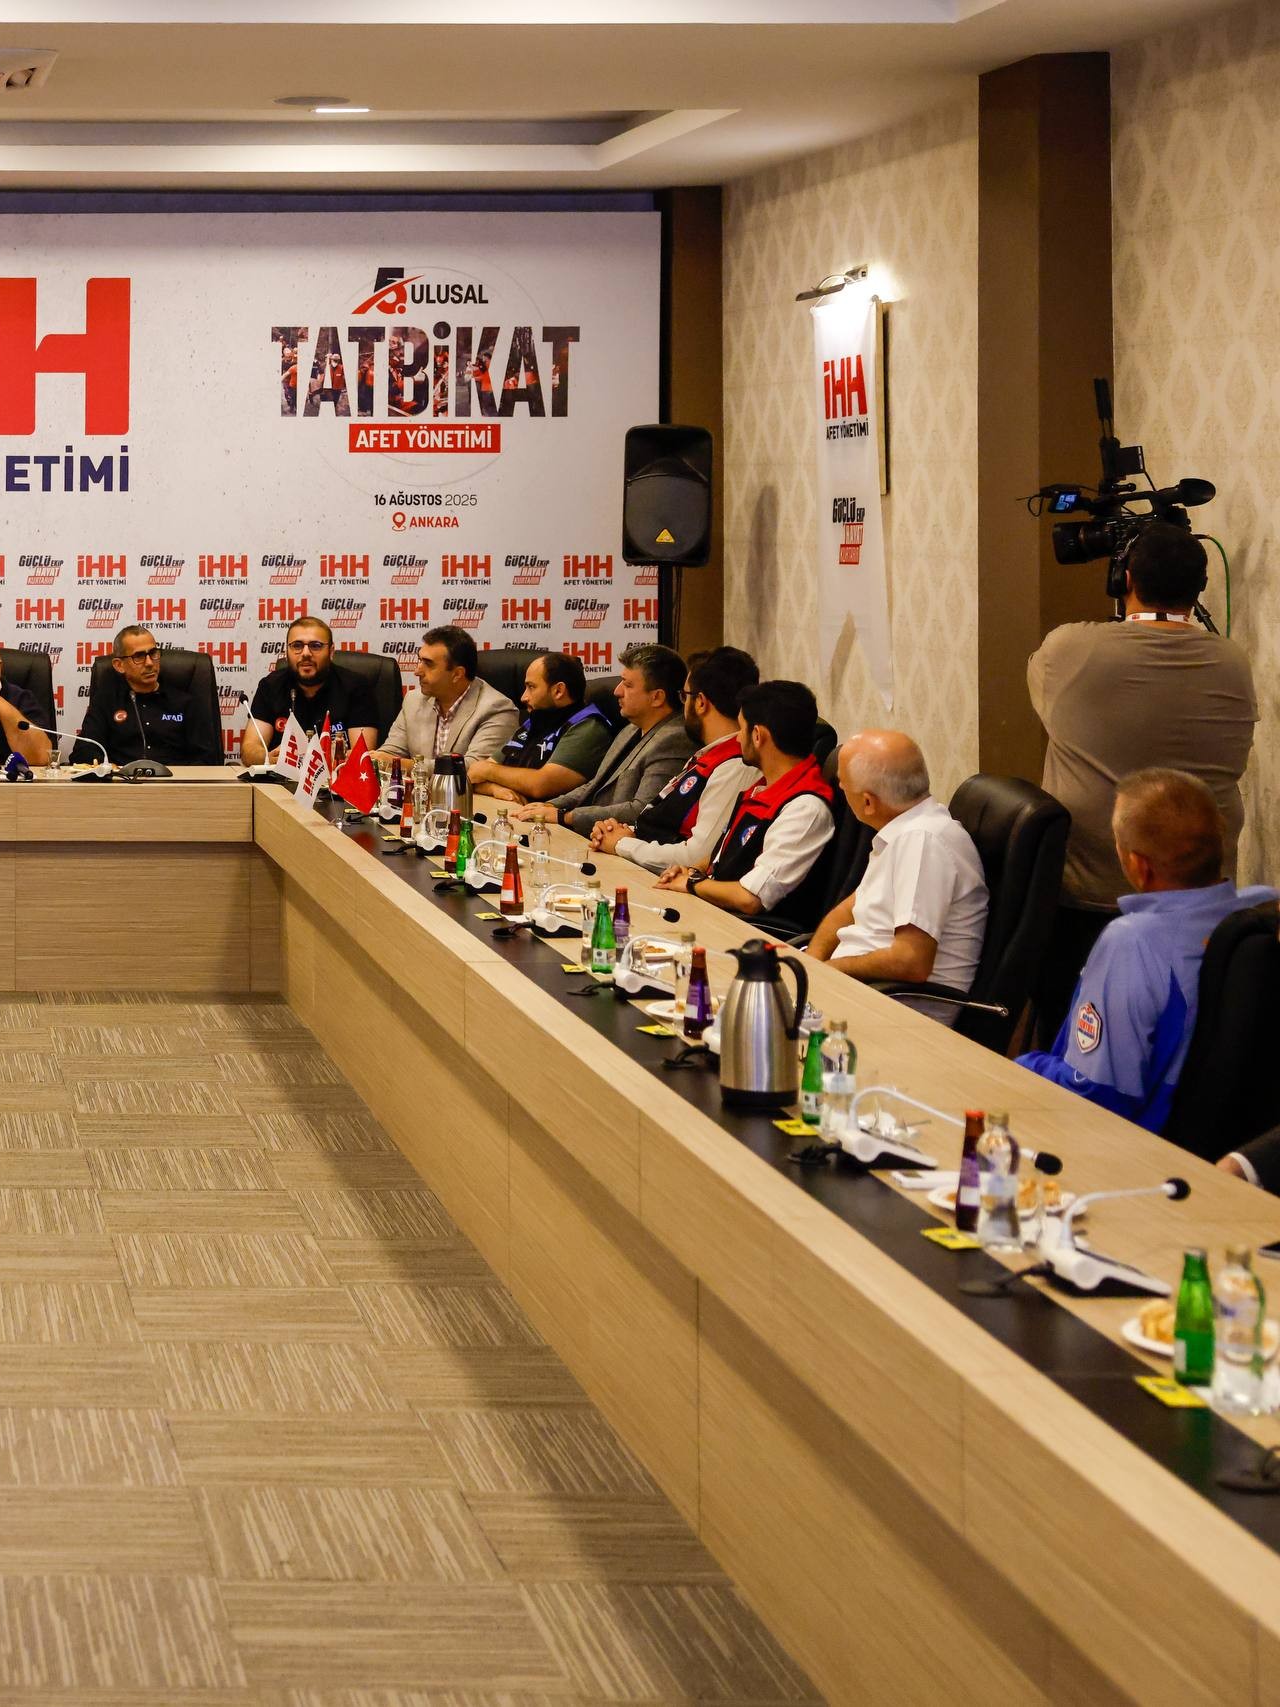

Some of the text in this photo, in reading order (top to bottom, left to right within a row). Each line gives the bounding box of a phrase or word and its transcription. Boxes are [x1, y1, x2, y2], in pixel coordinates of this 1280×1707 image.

[410, 284, 488, 304] ULUSAL
[271, 322, 580, 418] TATBİKAT
[826, 418, 869, 440] AFET YÖNETİMİ
[356, 425, 492, 448] AFET YÖNETİMİ
[374, 491, 478, 506] 16 AĞUSTOS 2025
[409, 517, 459, 528] ANKARA
[19, 555, 52, 568] GÜÇLÜ
[140, 555, 173, 568] GÜÇLÜ
[261, 555, 294, 568] GÜÇLÜ
[383, 555, 416, 568] GÜÇLÜ
[505, 555, 538, 568] GÜÇLÜ
[36, 567, 59, 576] HAYAT
[156, 567, 180, 576] HAYAT
[278, 567, 301, 576] HAYAT
[400, 567, 423, 576] HAYAT
[522, 567, 545, 576] HAYAT
[95, 577, 126, 586] YÖNETİMİ
[216, 577, 248, 585] YÖNETİMİ
[338, 577, 369, 585] YÖNETİMİ
[460, 577, 491, 585] YÖNETİMİ
[581, 577, 613, 586] YÖNETİMİ
[33, 621, 65, 629] YÖNETİMİ
[398, 620, 429, 629] YÖNETİMİ
